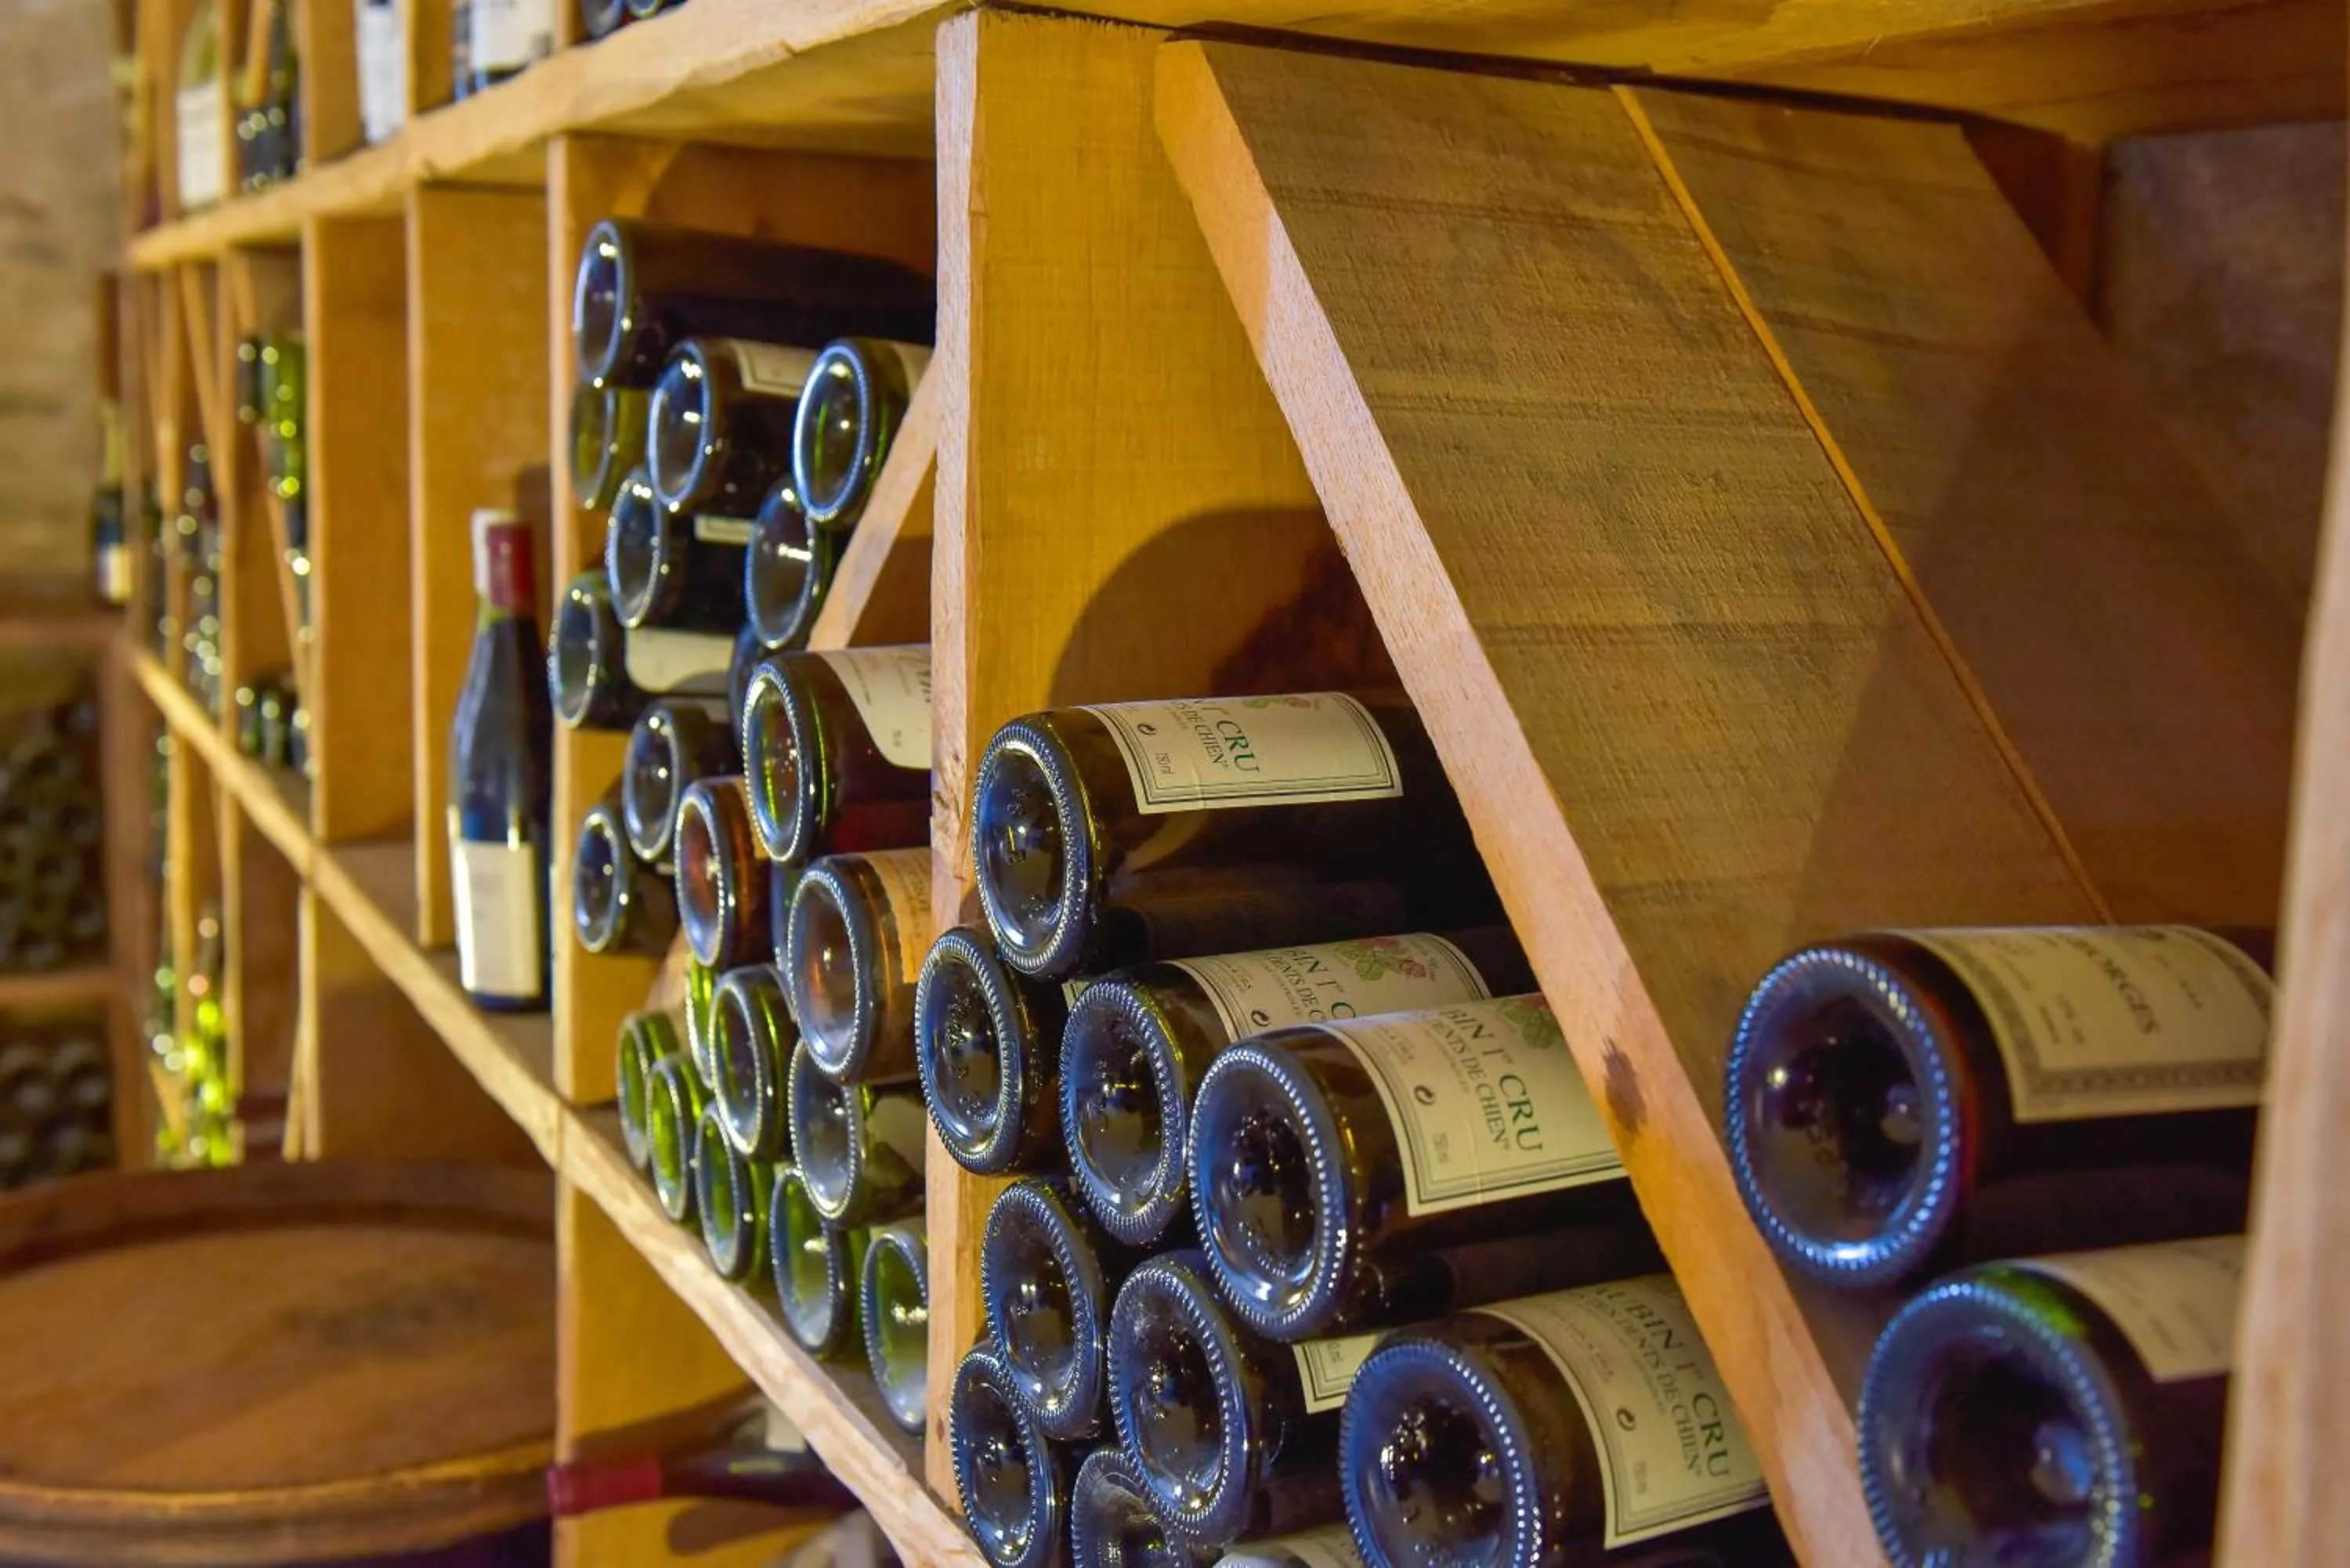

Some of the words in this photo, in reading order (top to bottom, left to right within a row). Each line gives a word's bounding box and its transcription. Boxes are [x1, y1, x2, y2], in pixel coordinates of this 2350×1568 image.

[1217, 720, 1260, 771] CRU
[1299, 988, 1318, 1006] DE
[1461, 1057, 1487, 1080] DE
[1500, 1075, 1542, 1151] CRU
[1656, 1374, 1679, 1400] DE
[1693, 1393, 1731, 1476] CRU
